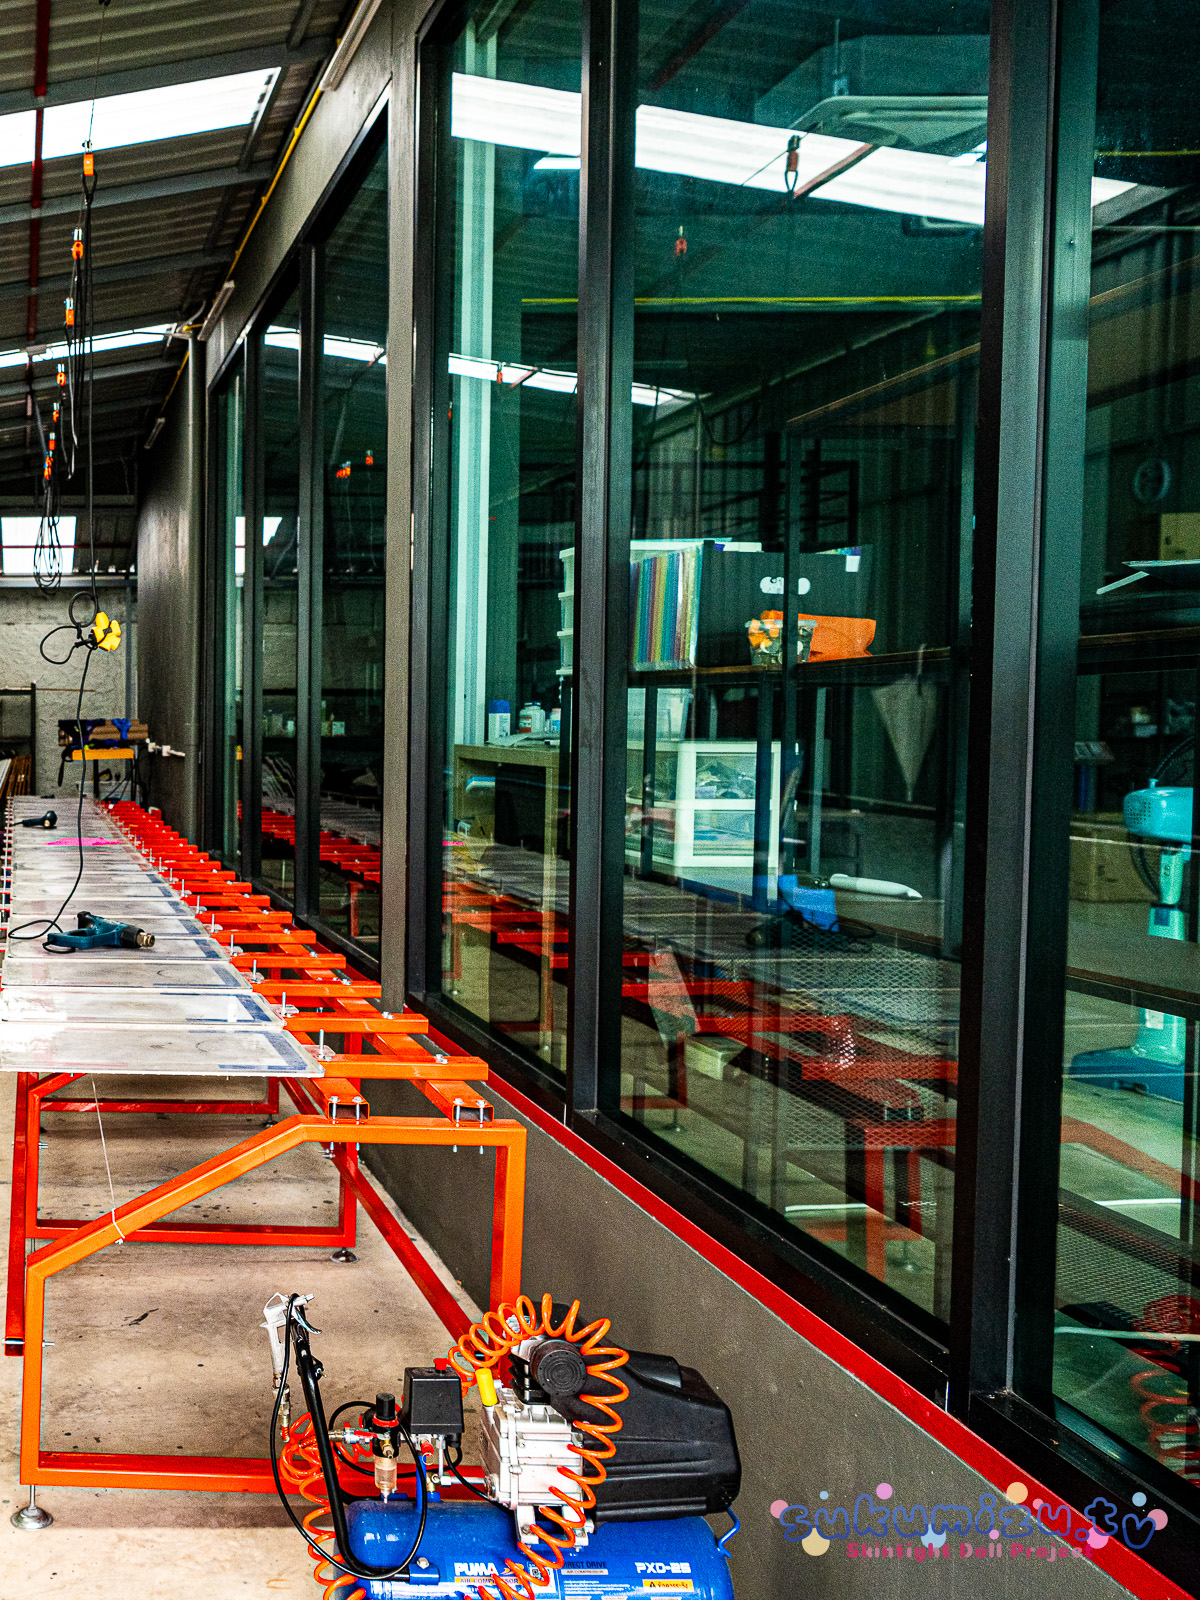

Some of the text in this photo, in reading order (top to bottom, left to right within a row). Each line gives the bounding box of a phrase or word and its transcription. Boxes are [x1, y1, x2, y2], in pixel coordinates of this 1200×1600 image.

[454, 1562, 499, 1576] PUMA
[586, 1561, 607, 1569] DRIVE
[634, 1562, 692, 1573] PXD-25
